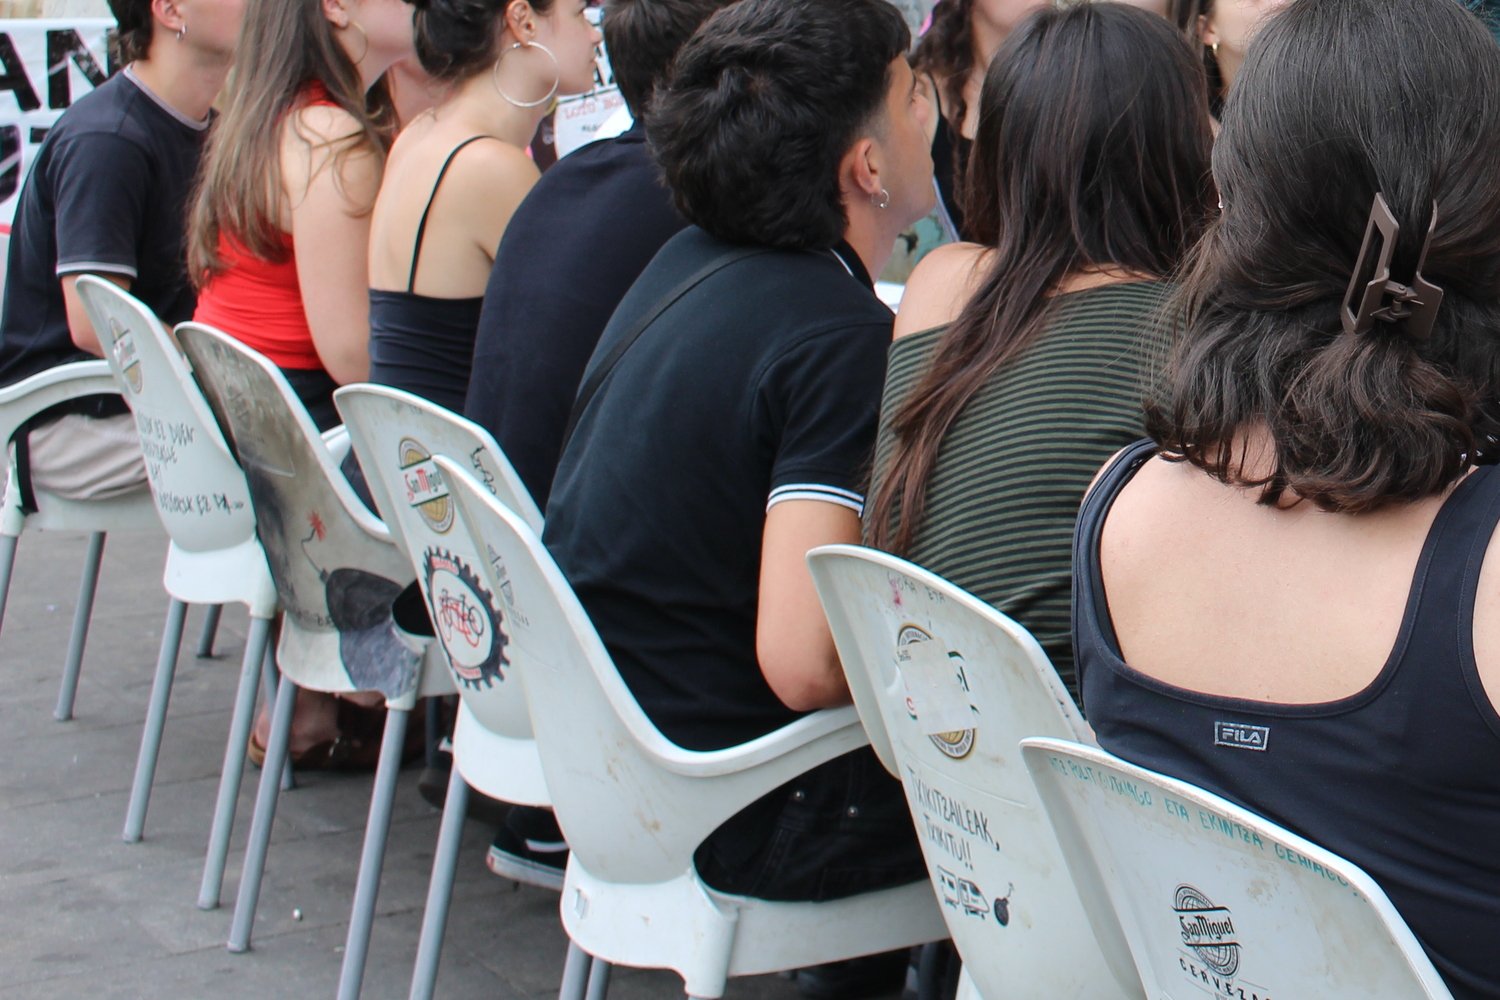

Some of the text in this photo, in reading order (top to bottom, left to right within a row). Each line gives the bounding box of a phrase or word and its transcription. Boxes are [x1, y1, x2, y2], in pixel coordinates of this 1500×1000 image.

[1222, 727, 1262, 745] FILA
[1164, 797, 1191, 823] ETA
[1199, 810, 1264, 851] EKINTZA
[1179, 957, 1273, 1000] CERVEZA
